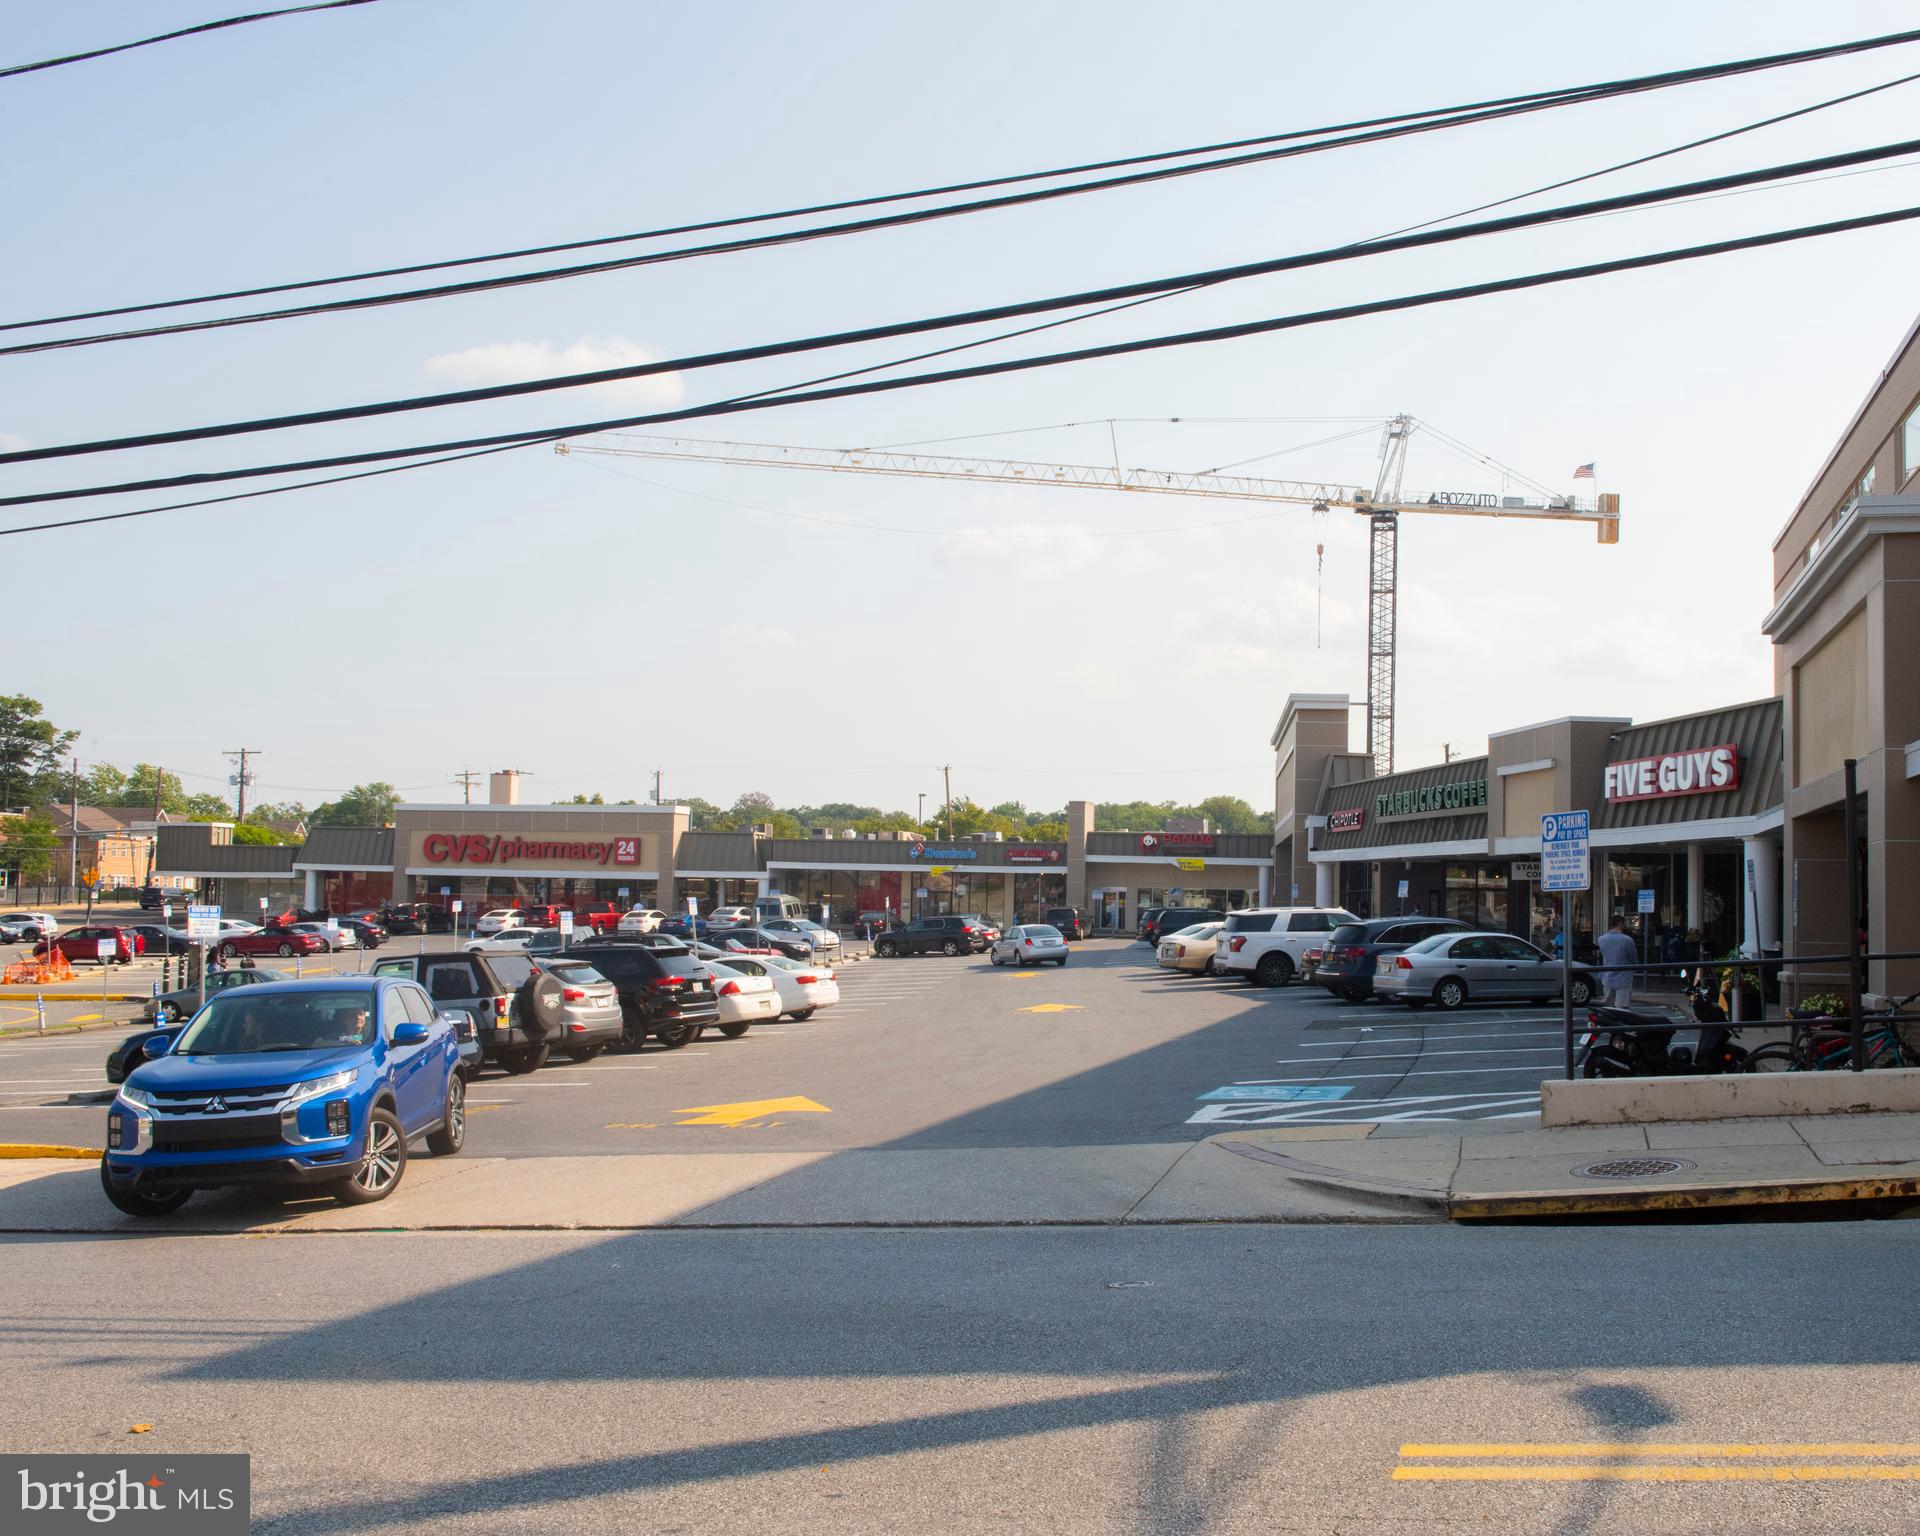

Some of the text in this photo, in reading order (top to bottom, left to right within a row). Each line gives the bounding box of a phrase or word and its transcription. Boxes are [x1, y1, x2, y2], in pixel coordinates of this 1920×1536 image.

[1440, 492, 1497, 507] BOZZUTO
[1604, 748, 1733, 799] FIVE GUYS
[1376, 778, 1488, 817] STARBUCKS COFFE
[1331, 812, 1358, 828] CHIPOTLE
[1558, 814, 1587, 830] PARKING
[1162, 832, 1214, 846] PANDA
[1558, 828, 1587, 840] PAY BY SPACE
[422, 833, 635, 865] CVS/pharmacy 24
[924, 847, 977, 859] Domino's
[1515, 863, 1540, 871] STAR
